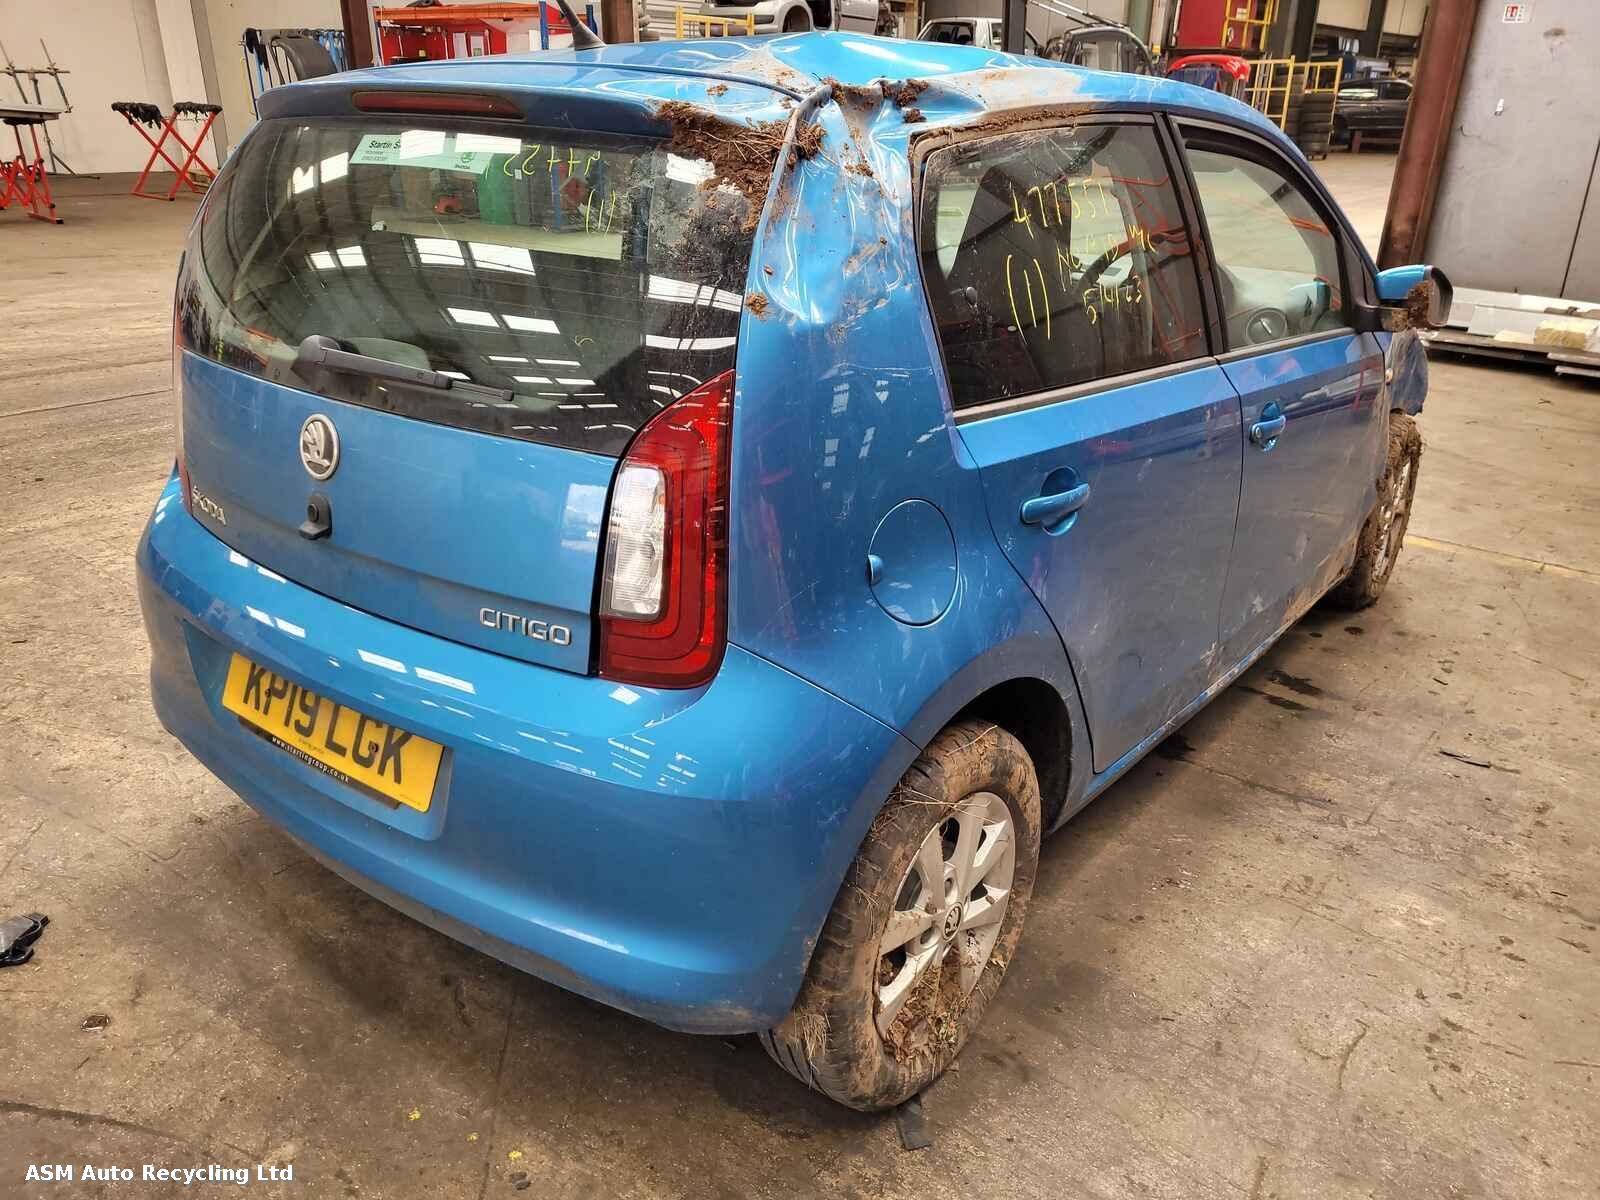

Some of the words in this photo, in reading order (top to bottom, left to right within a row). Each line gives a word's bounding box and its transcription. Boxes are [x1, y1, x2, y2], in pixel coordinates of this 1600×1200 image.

[479, 606, 572, 647] CITIGO
[242, 660, 322, 738] KP19
[324, 699, 414, 785] LGK
[271, 736, 352, 784] www.startingroup.co.uk
